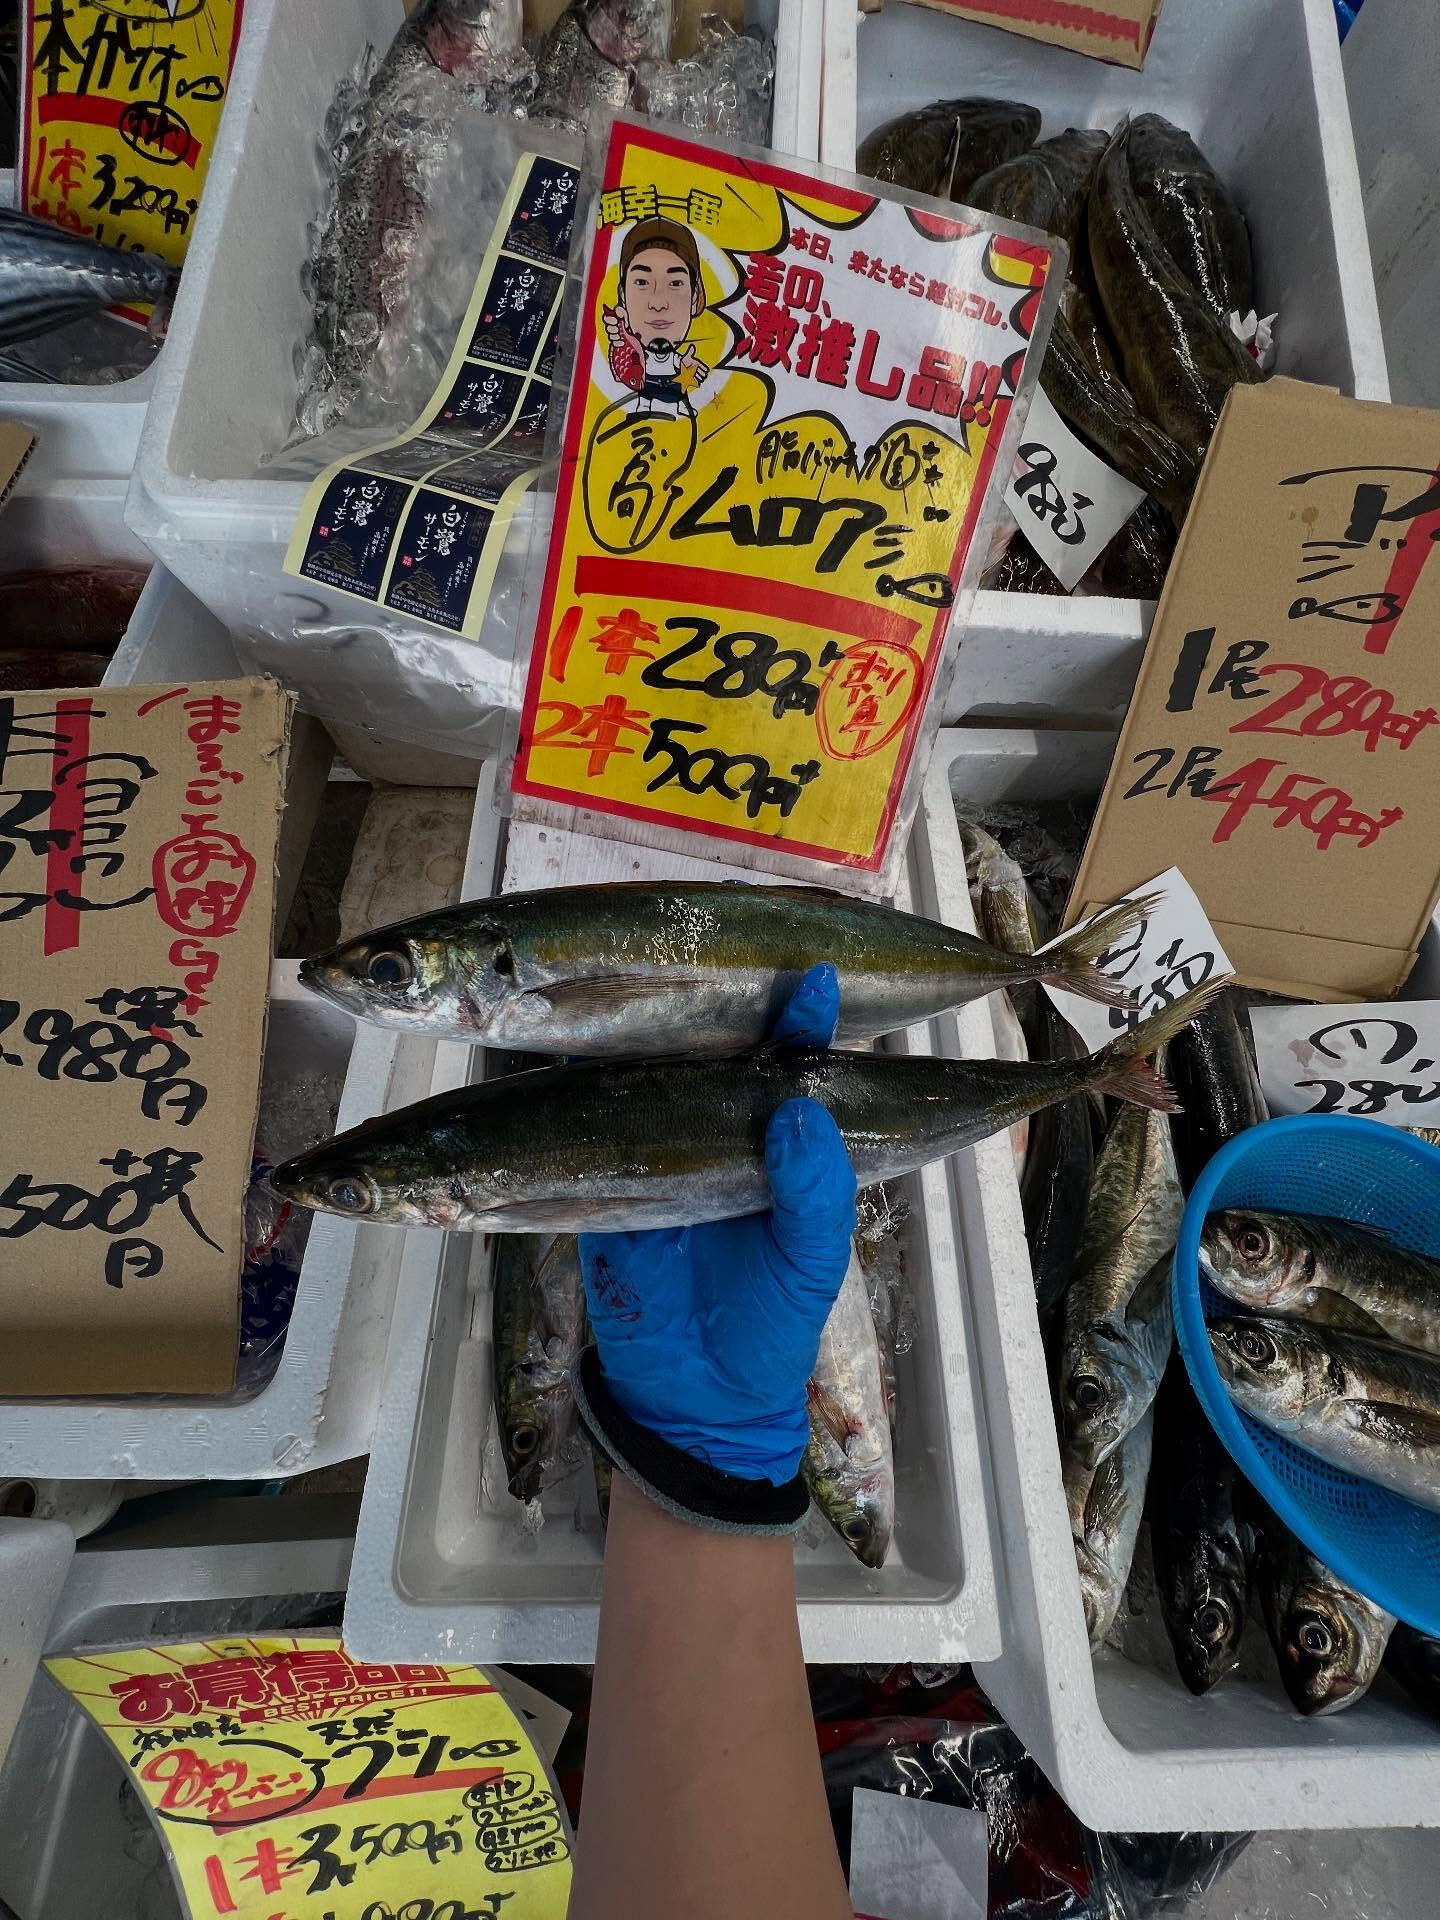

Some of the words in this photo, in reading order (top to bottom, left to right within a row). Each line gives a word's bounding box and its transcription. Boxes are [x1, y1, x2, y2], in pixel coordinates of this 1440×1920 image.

[331, 486, 356, 532] サーモン
[415, 513, 437, 562] サーモン
[533, 694, 650, 778] 2本
[263, 1699, 329, 1718] BEST
[333, 1687, 428, 1706] PRICE!!
